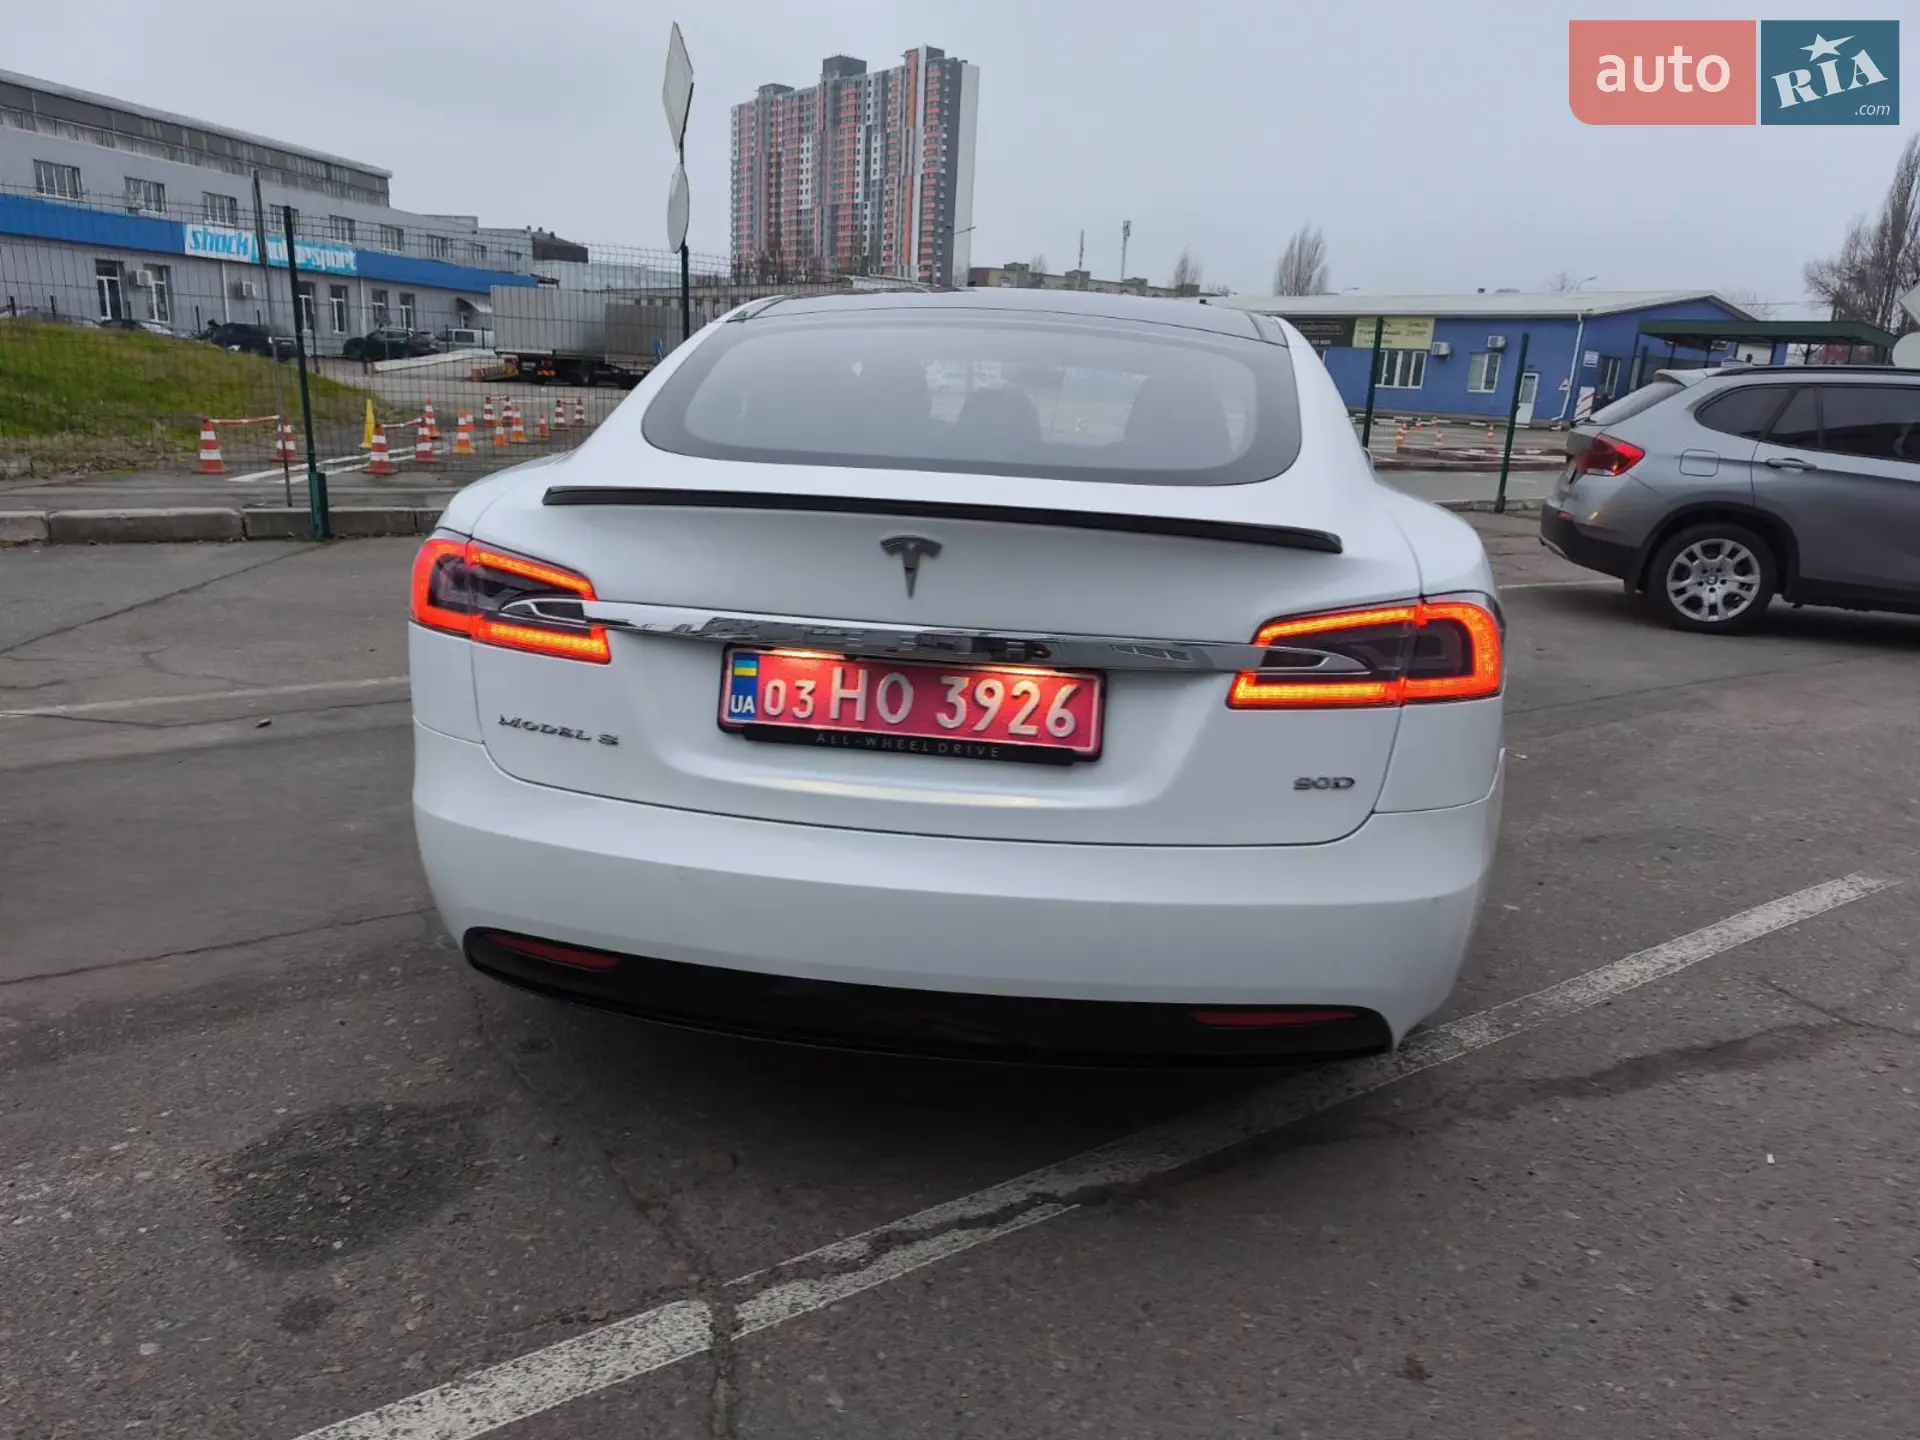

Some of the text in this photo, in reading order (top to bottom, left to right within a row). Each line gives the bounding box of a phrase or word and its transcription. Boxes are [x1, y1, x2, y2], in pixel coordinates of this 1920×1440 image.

[731, 694, 756, 715] UA
[763, 666, 1081, 739] 03 HO 3926
[498, 715, 592, 741] MODEL
